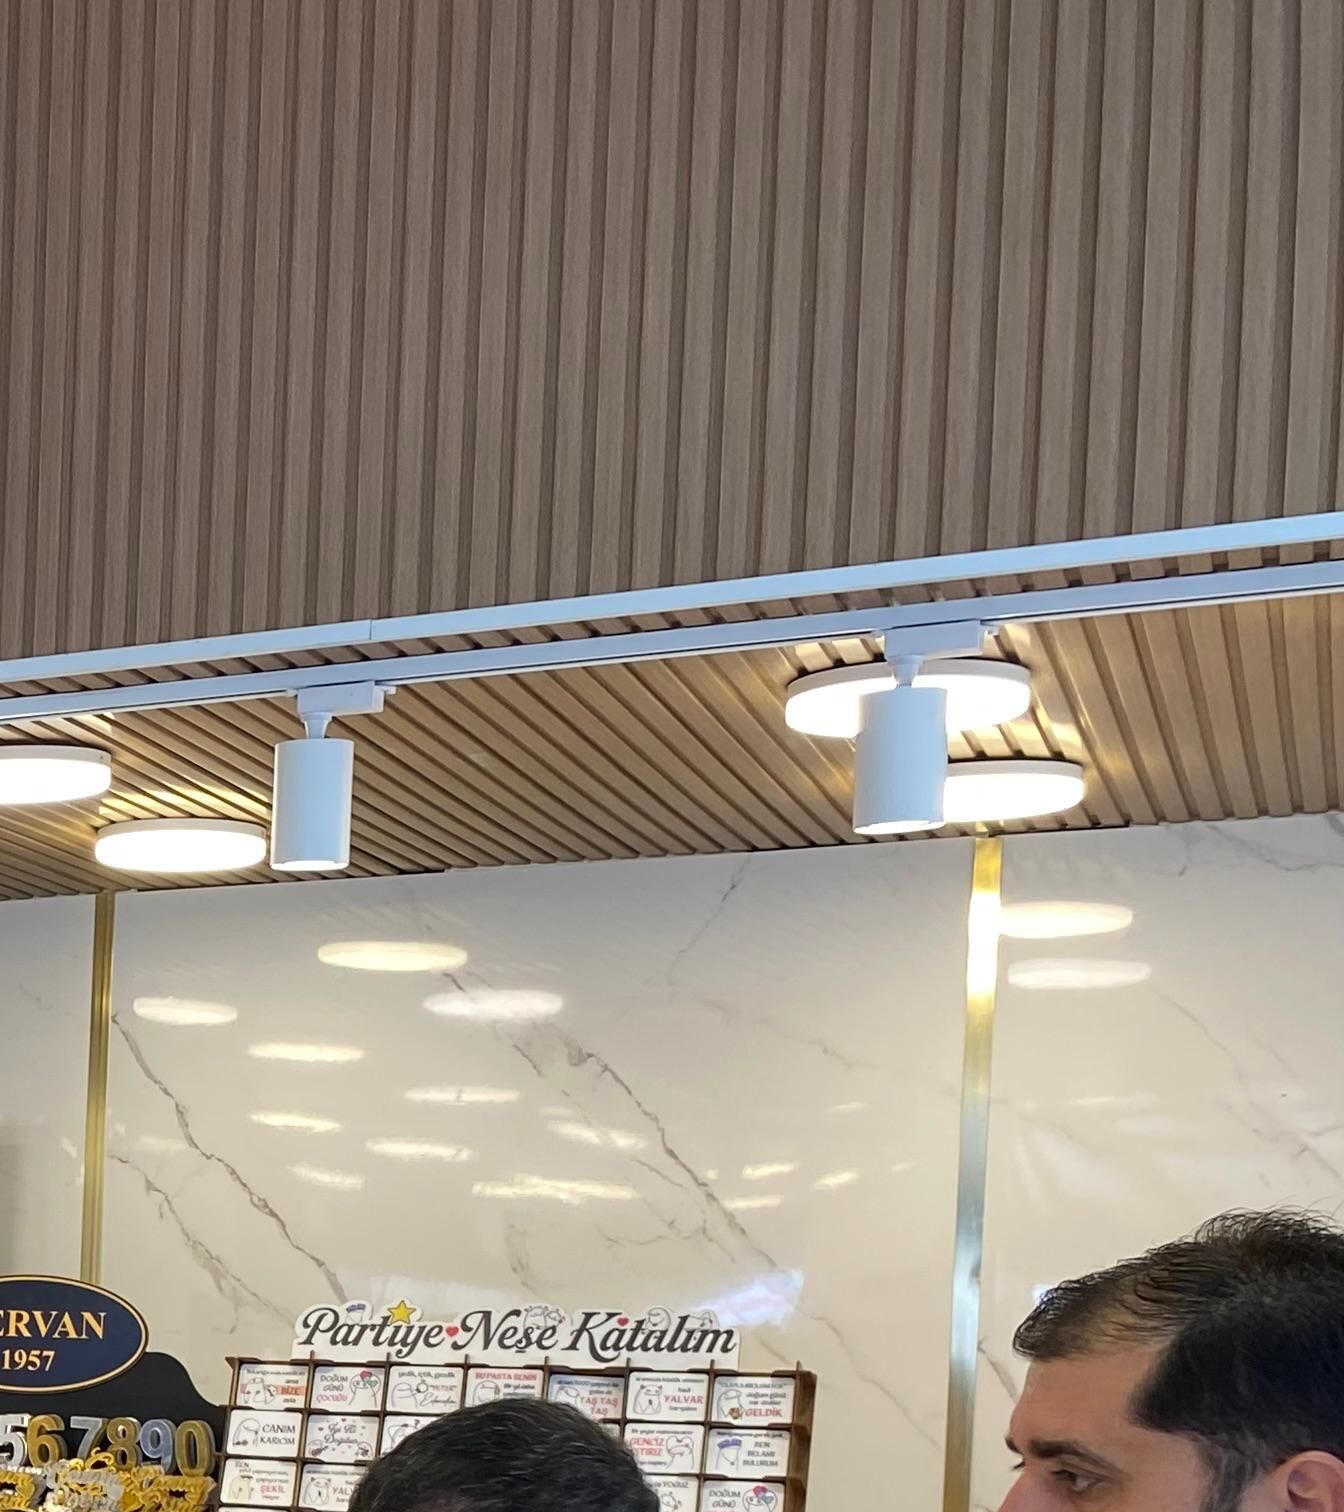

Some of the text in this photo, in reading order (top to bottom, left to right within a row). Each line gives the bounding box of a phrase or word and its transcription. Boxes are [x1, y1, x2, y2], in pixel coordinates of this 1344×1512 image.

[451, 1307, 558, 1354] Neşe
[561, 1310, 736, 1363] Katalım
[1, 1349, 55, 1372] 1957
[320, 1373, 348, 1382] DOĞUM
[323, 1383, 344, 1392] GÜNÜ
[664, 1394, 704, 1405] YALVAR
[745, 1406, 783, 1417] GELDİK
[263, 1424, 296, 1433] CANIM
[709, 1489, 740, 1498] DOĞUM
[712, 1499, 736, 1508] GÜNÜ
